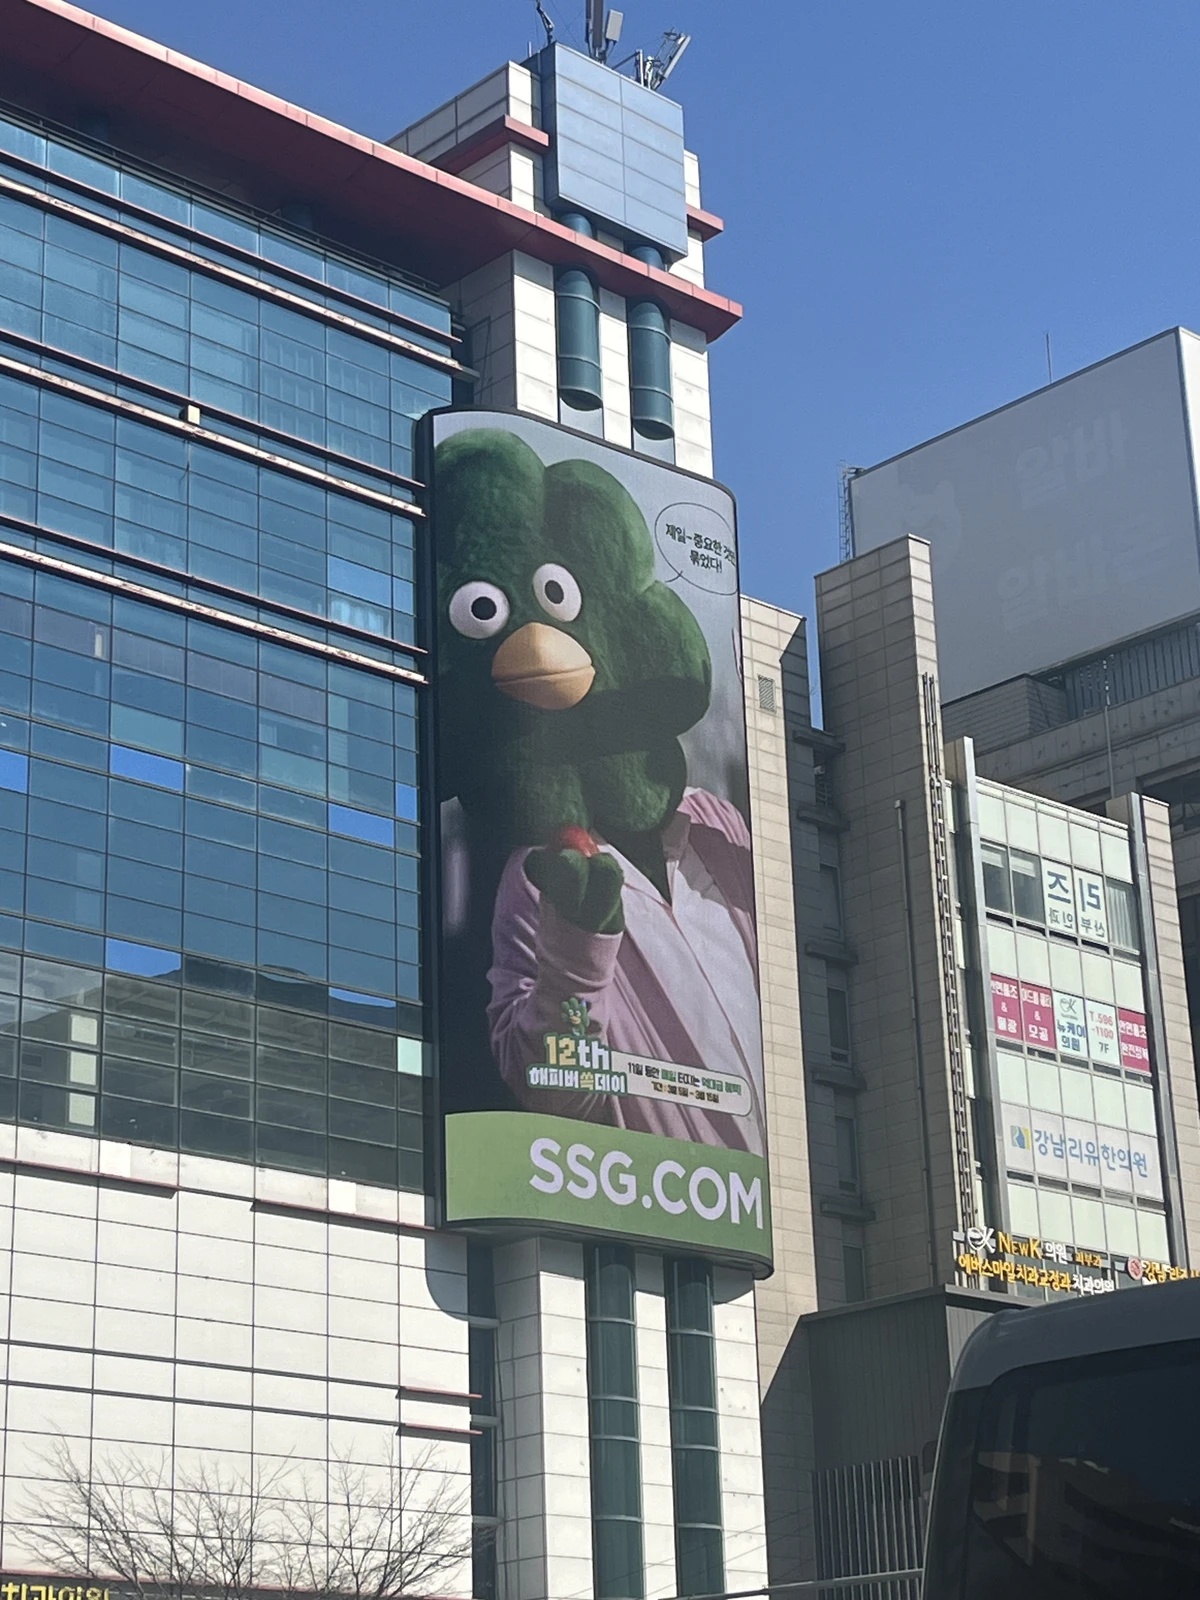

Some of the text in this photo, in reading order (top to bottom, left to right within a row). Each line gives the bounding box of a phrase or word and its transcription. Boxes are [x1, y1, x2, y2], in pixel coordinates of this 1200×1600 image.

[1028, 1024, 1049, 1042] 모공
[1057, 1019, 1087, 1038] 뉴케이
[545, 1036, 611, 1071] 12th
[1061, 1035, 1081, 1052] 의원
[1098, 1041, 1109, 1054] 7F
[529, 1067, 626, 1094] 해피버쓱데이
[645, 1065, 659, 1079] 동안
[1034, 1129, 1149, 1178] 강남리유한의원
[528, 1137, 764, 1230] SSG.COM
[1044, 1241, 1069, 1265] 의원
[1074, 1252, 1102, 1269] 피부과
